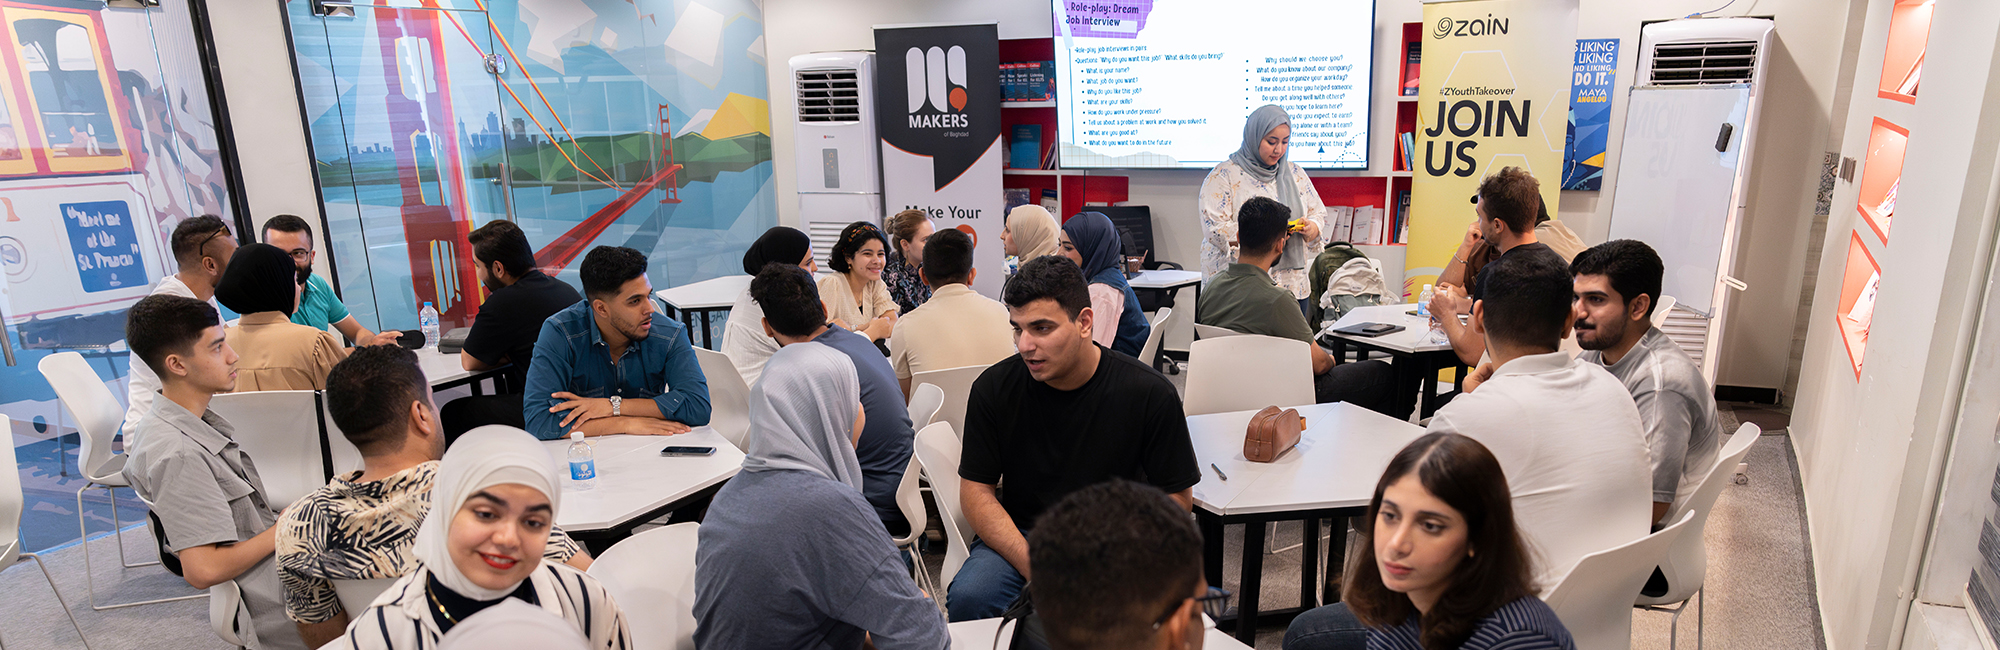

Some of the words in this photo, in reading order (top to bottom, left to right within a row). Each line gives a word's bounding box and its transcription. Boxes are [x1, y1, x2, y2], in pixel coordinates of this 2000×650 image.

[1071, 2, 1111, 14] Role-play:
[1114, 4, 1138, 14] Dream
[1066, 15, 1080, 24] Job
[1082, 16, 1120, 26] Interview
[1580, 42, 1614, 52] LIKING
[1578, 52, 1614, 63] LIKING
[1574, 72, 1592, 86] DO
[1440, 86, 1515, 95] #ZYouthTakeover
[908, 114, 968, 128] MAKERS
[1425, 100, 1531, 137] JOIN
[1425, 140, 1478, 177] US
[948, 205, 981, 219] Your
